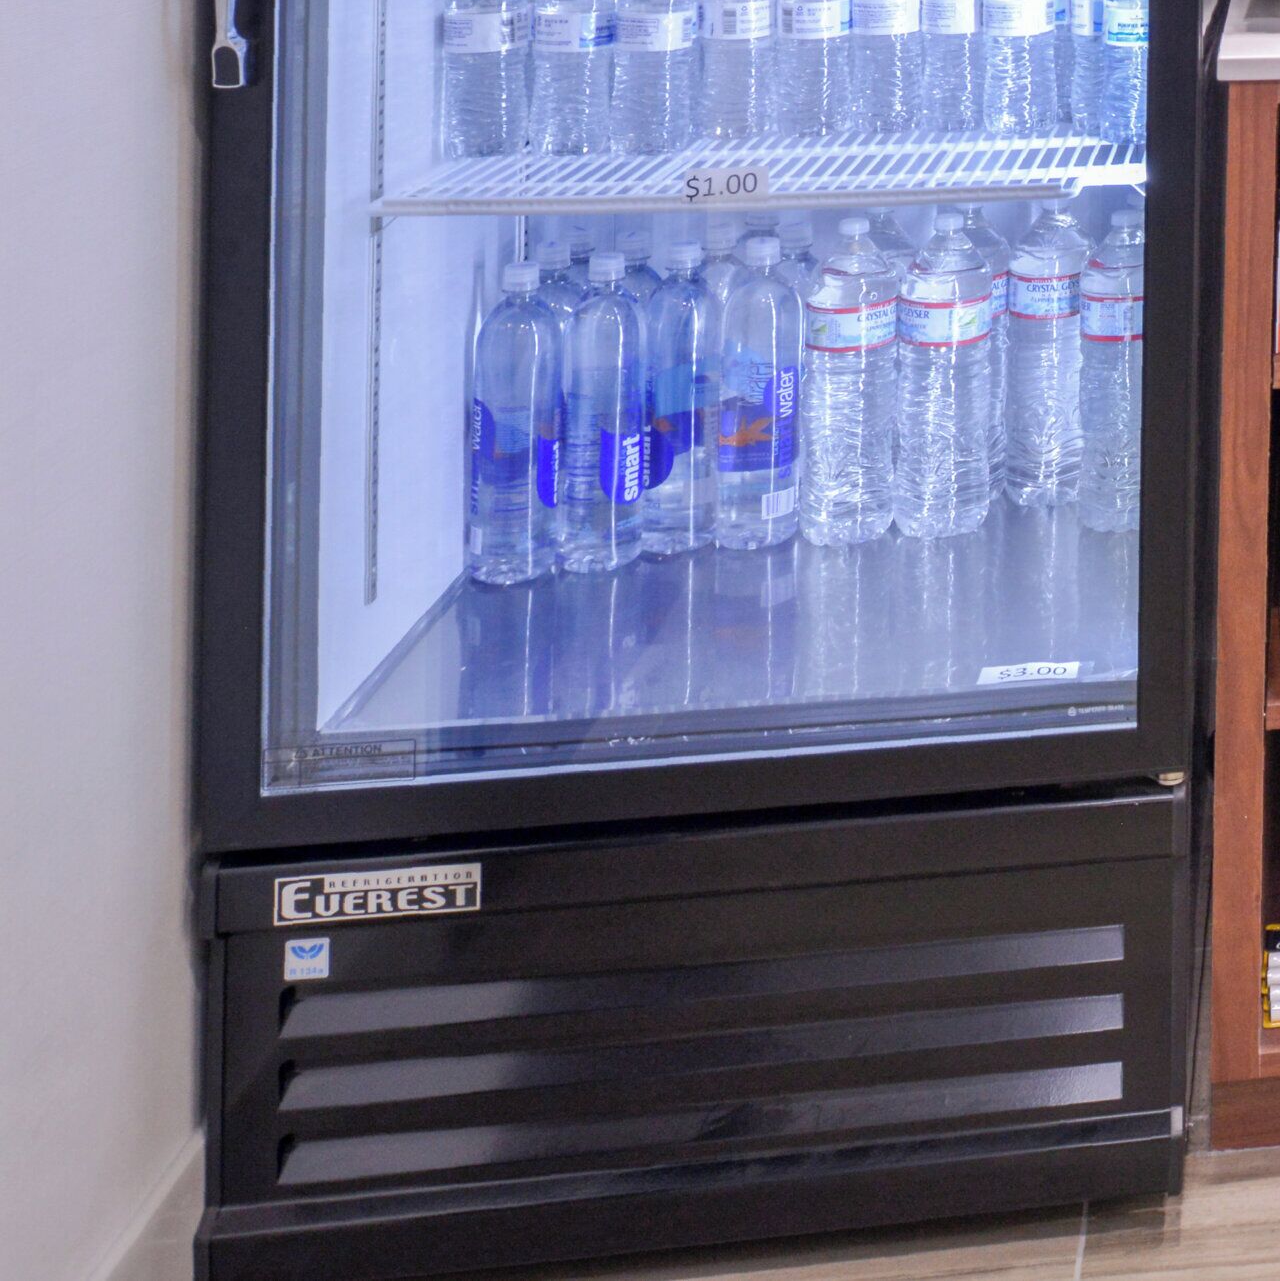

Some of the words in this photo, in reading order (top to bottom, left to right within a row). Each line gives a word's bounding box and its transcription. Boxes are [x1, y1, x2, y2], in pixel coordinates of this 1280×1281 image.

[686, 172, 758, 202] $1.00
[779, 368, 795, 419] water
[998, 665, 1067, 680] $3.00
[329, 870, 474, 890] REFRIGERATION
[281, 881, 474, 919] EVEREST
